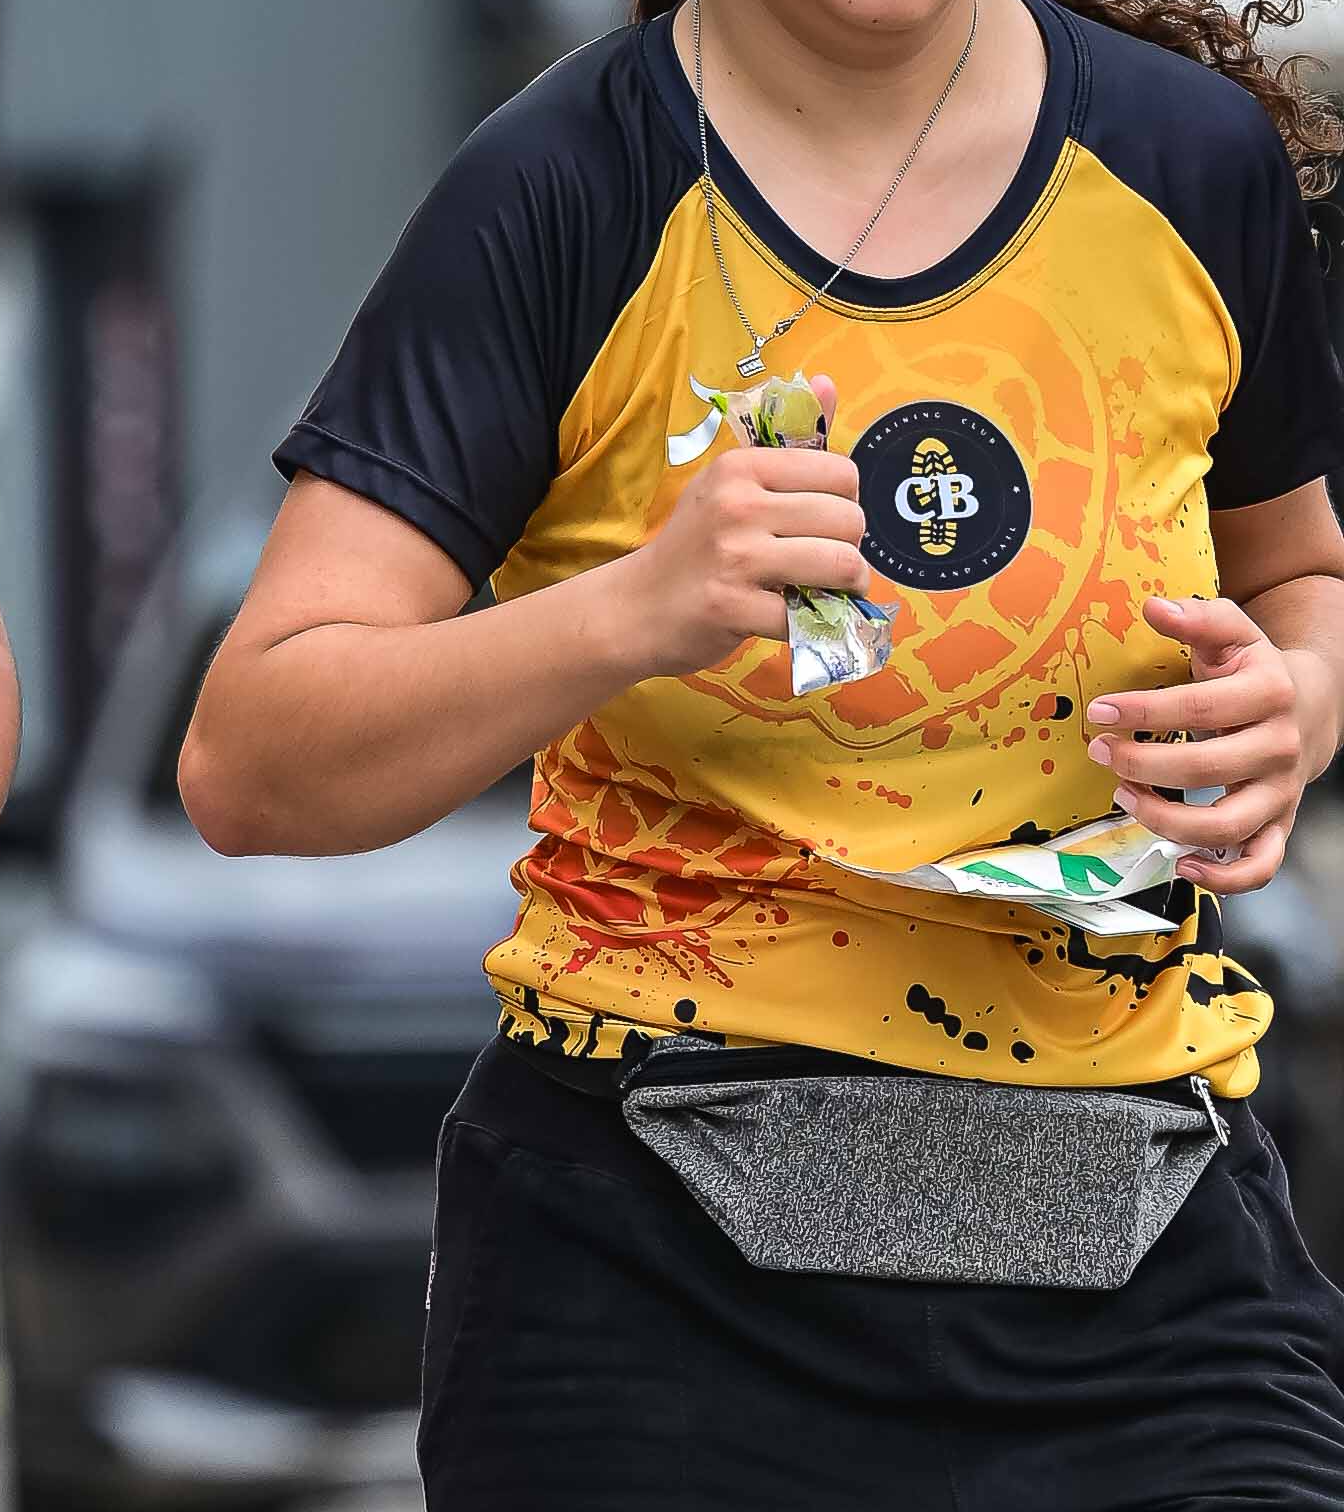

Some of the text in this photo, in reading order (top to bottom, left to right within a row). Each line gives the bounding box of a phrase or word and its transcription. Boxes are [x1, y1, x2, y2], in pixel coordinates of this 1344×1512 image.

[867, 410, 997, 450] TRAINING CLUB
[895, 473, 979, 522] CB
[940, 566, 972, 579] AND
[982, 526, 1016, 566] TRAIL
